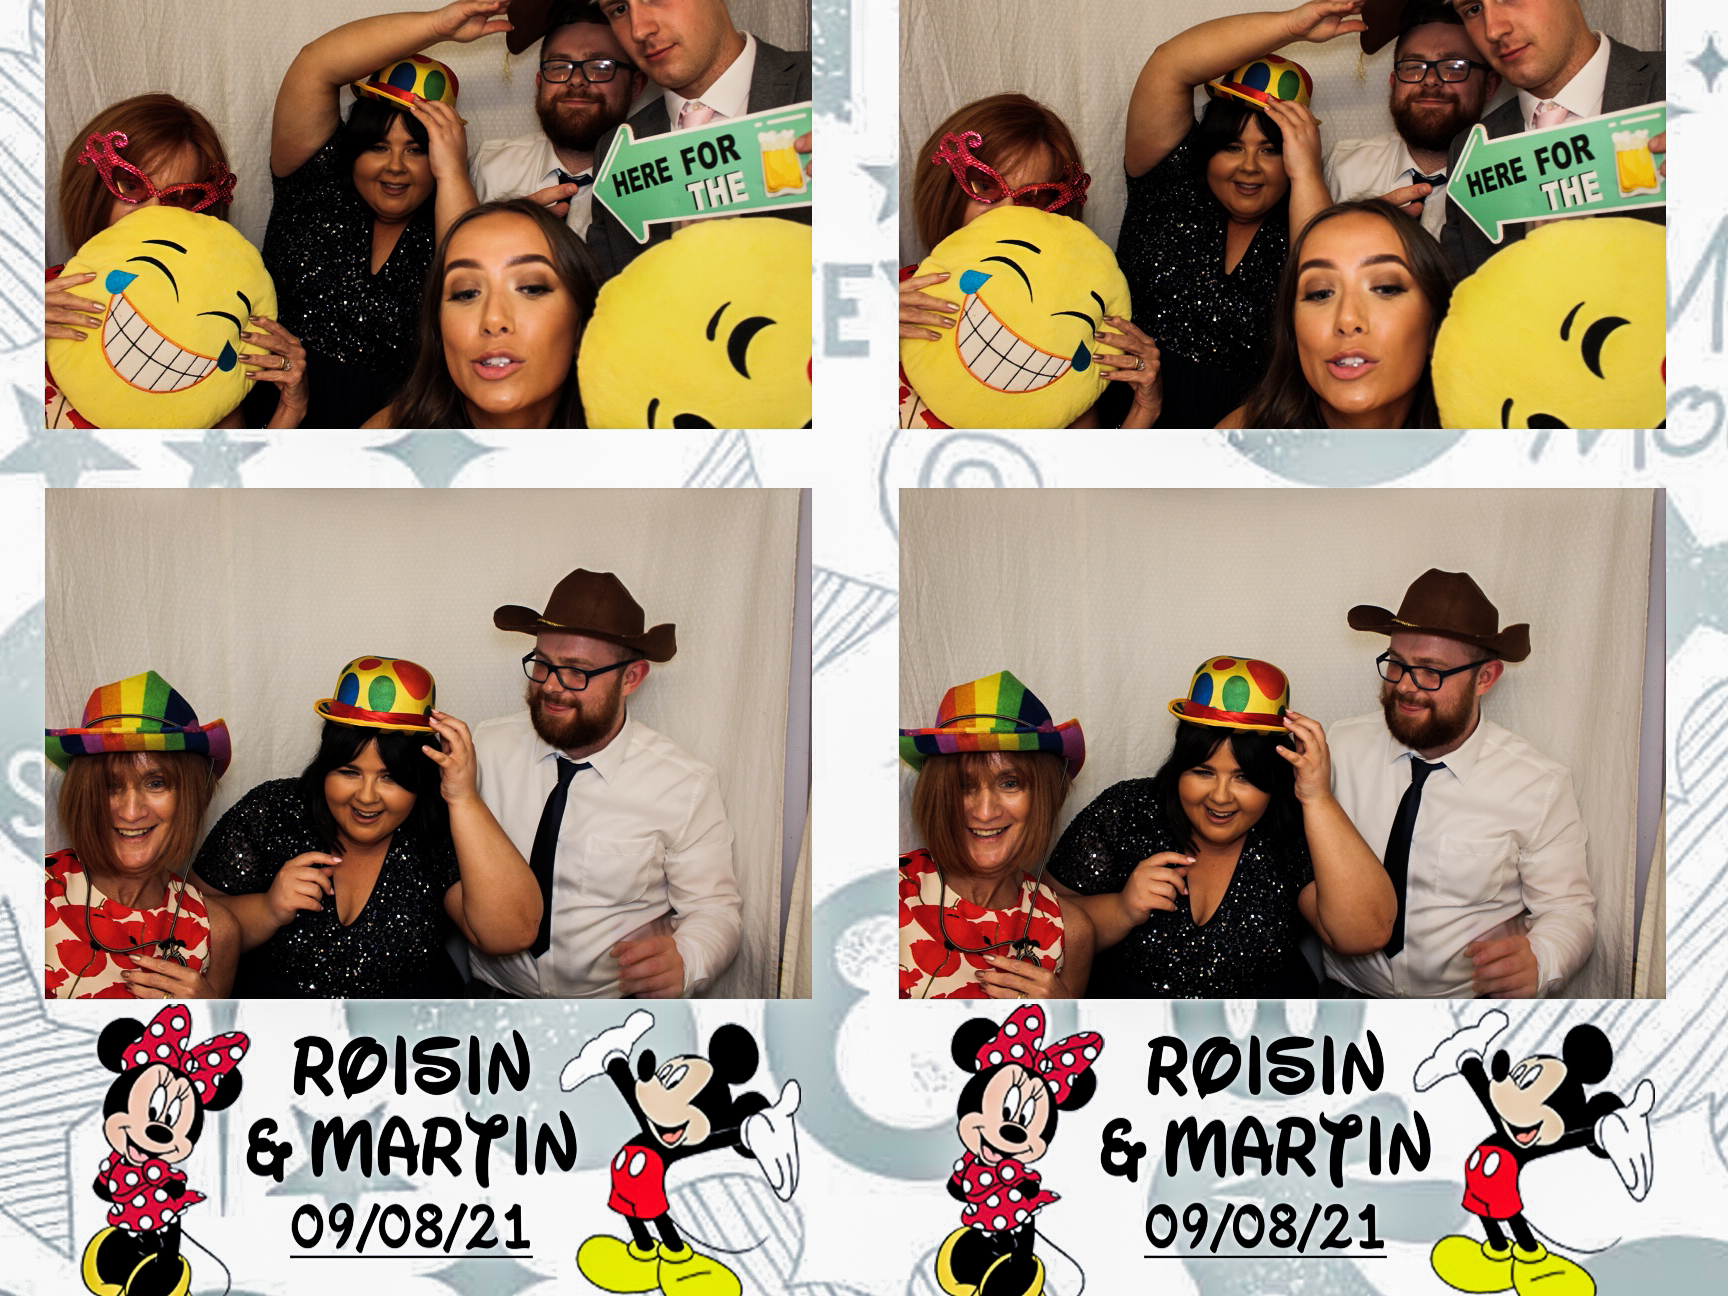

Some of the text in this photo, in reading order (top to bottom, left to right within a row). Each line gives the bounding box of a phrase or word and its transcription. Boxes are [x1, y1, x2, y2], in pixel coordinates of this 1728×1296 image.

[612, 134, 741, 197] HERE FOR
[685, 171, 749, 211] THE
[1466, 134, 1595, 197] HERE FOR
[1539, 171, 1603, 211] THE
